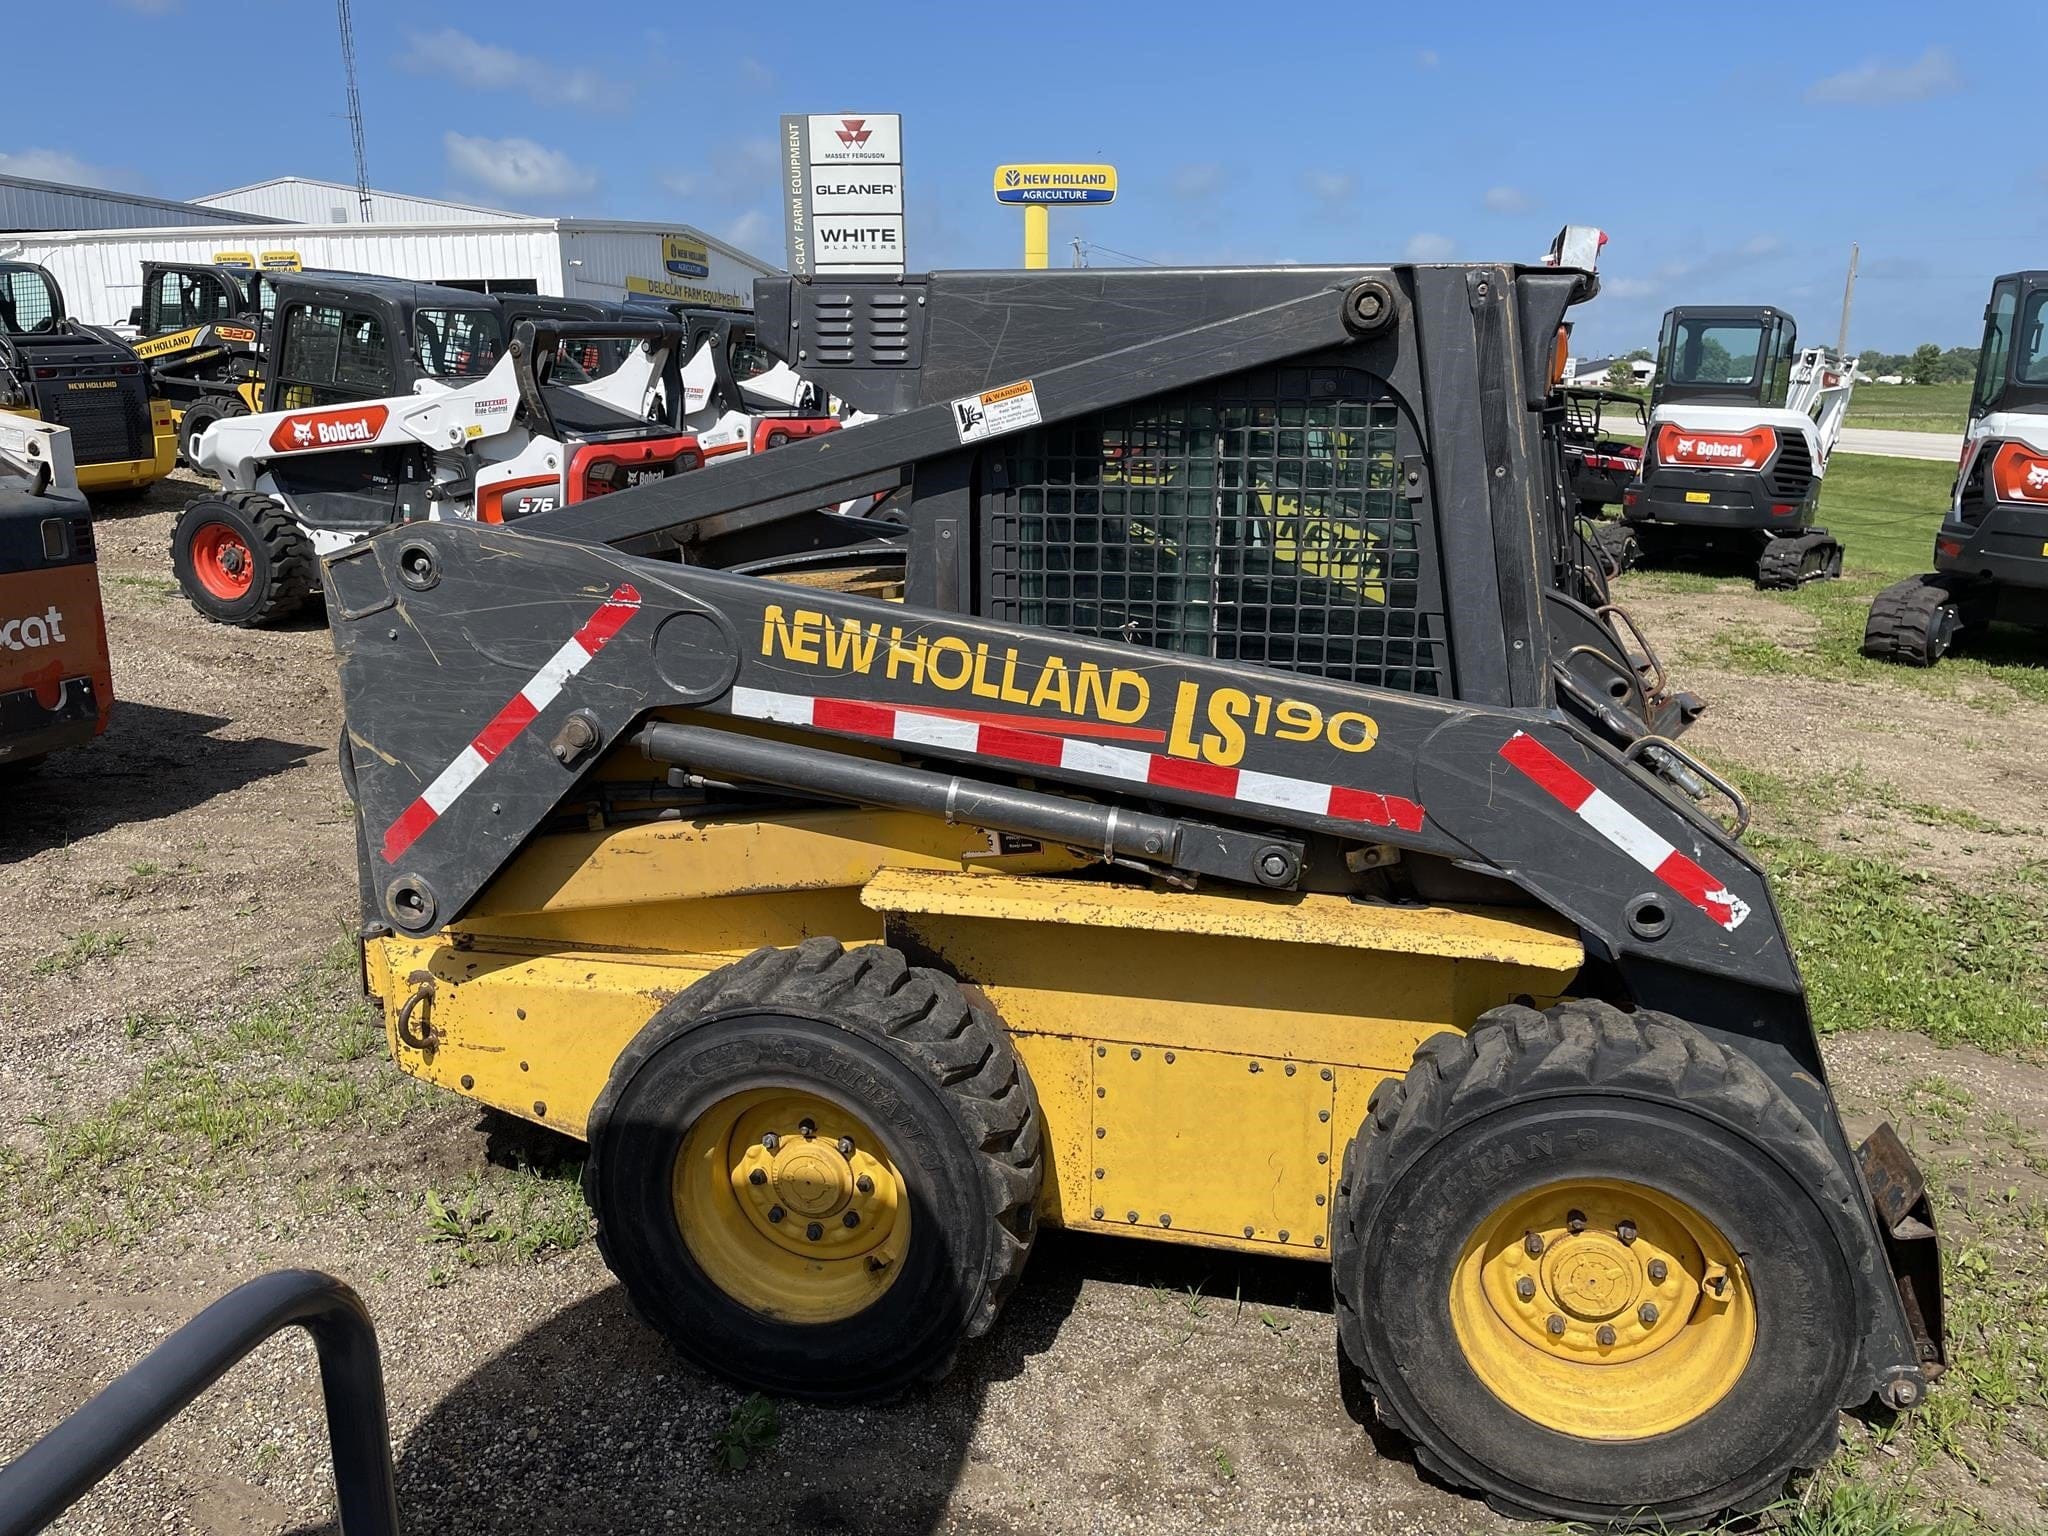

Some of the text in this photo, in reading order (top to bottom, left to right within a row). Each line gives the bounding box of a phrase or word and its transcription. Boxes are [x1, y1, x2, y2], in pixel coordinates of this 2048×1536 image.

[789, 123, 802, 195] EQUIPMENT
[1023, 174, 1106, 185] NEW HOLLAND
[816, 184, 894, 195] GLEANER
[1022, 190, 1088, 200] AGRICULTURE
[792, 197, 804, 232] FARM
[821, 229, 896, 242] WHITE
[648, 280, 740, 305] DEL-CLAY FARM EQUIPMENT
[154, 335, 190, 353] HOLLAND
[68, 381, 117, 390] NEW HOLLAND
[993, 385, 1028, 400] WARNING
[488, 405, 508, 414] Control
[318, 419, 372, 443] Bobcat
[1696, 441, 1744, 458] Bobcat
[639, 470, 665, 488] Bobcat
[518, 497, 554, 513] S76
[0, 606, 66, 651] cat
[761, 604, 881, 674] NEW
[885, 626, 1150, 724] HOLLAND
